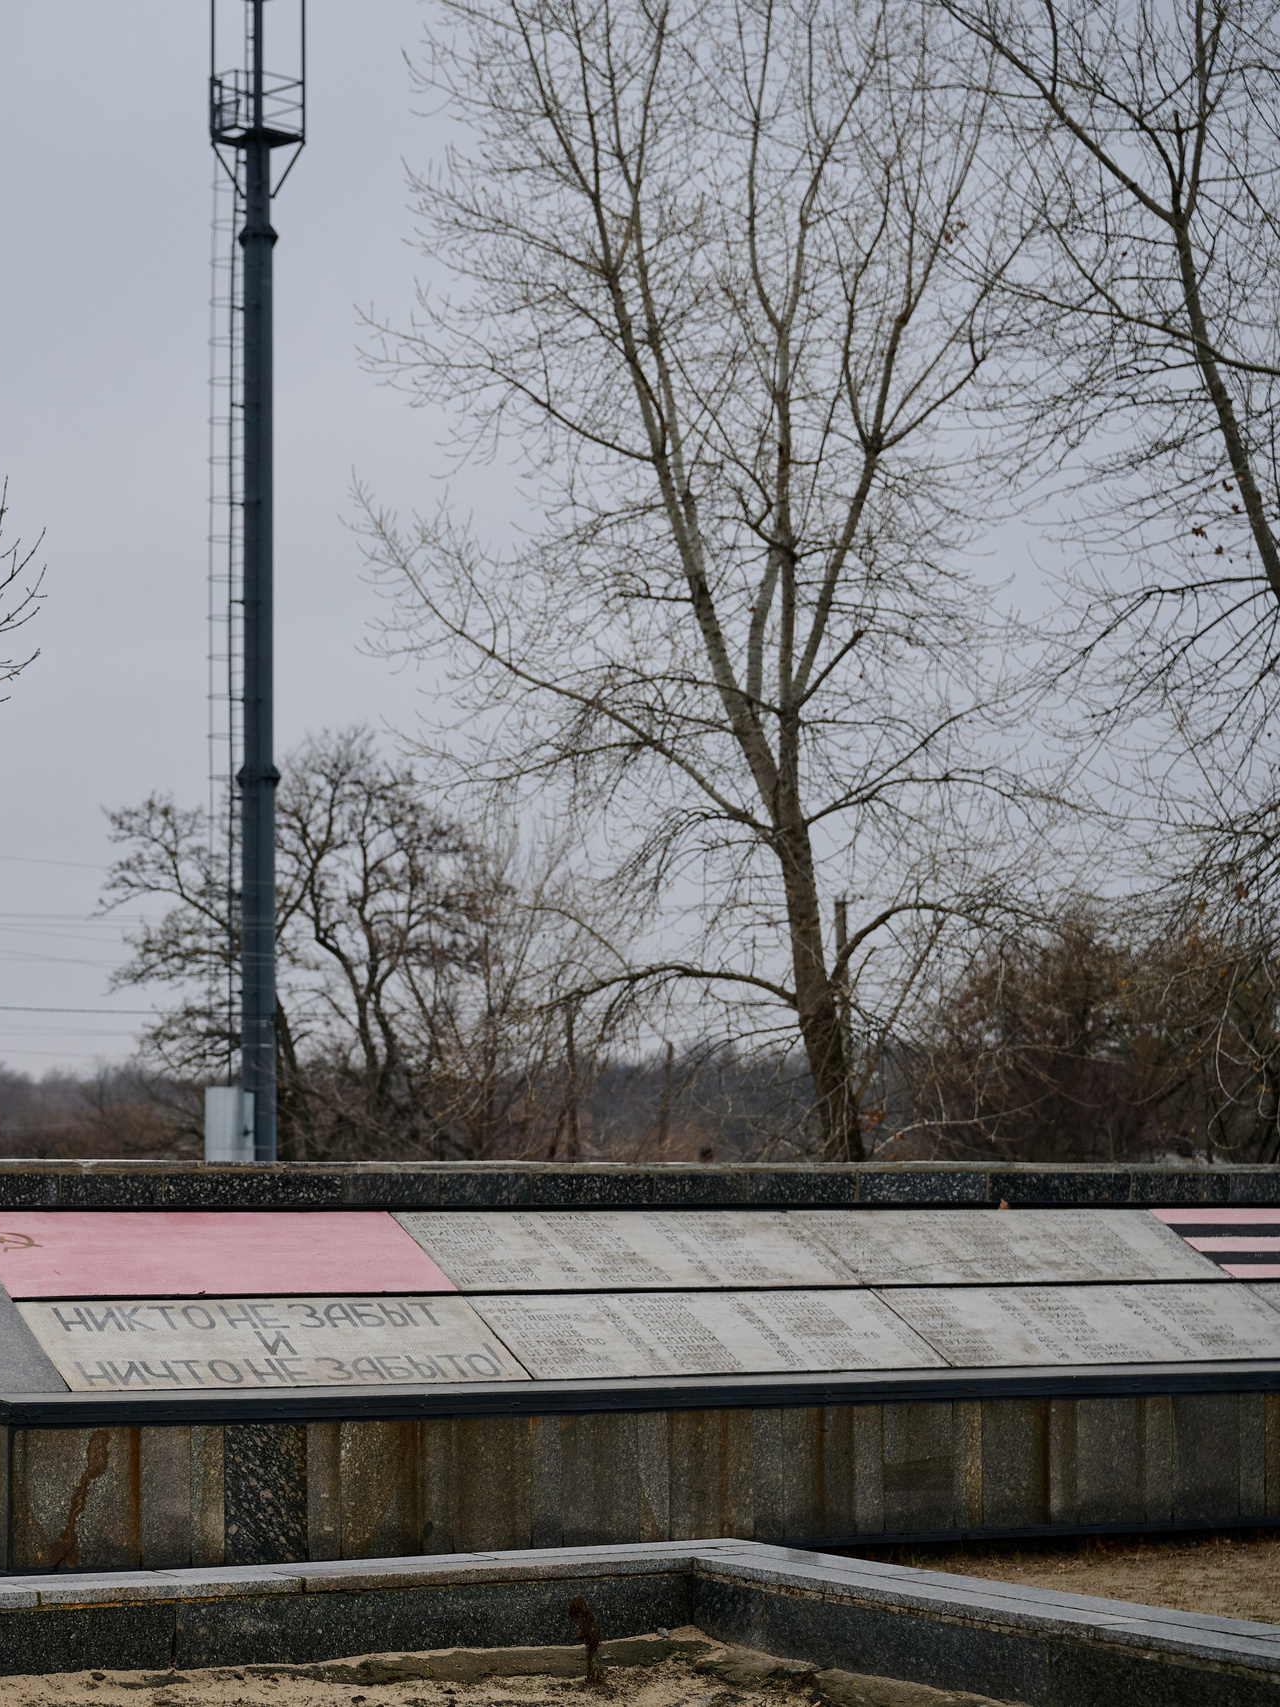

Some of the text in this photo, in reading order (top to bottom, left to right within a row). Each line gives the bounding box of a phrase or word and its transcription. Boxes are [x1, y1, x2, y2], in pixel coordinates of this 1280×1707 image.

[52, 1302, 442, 1332] НИКТО НЕ ЗАБЫТ
[254, 1330, 299, 1356] И
[73, 1343, 513, 1387] НИЧТО НЕ ЗАБЫТО!
